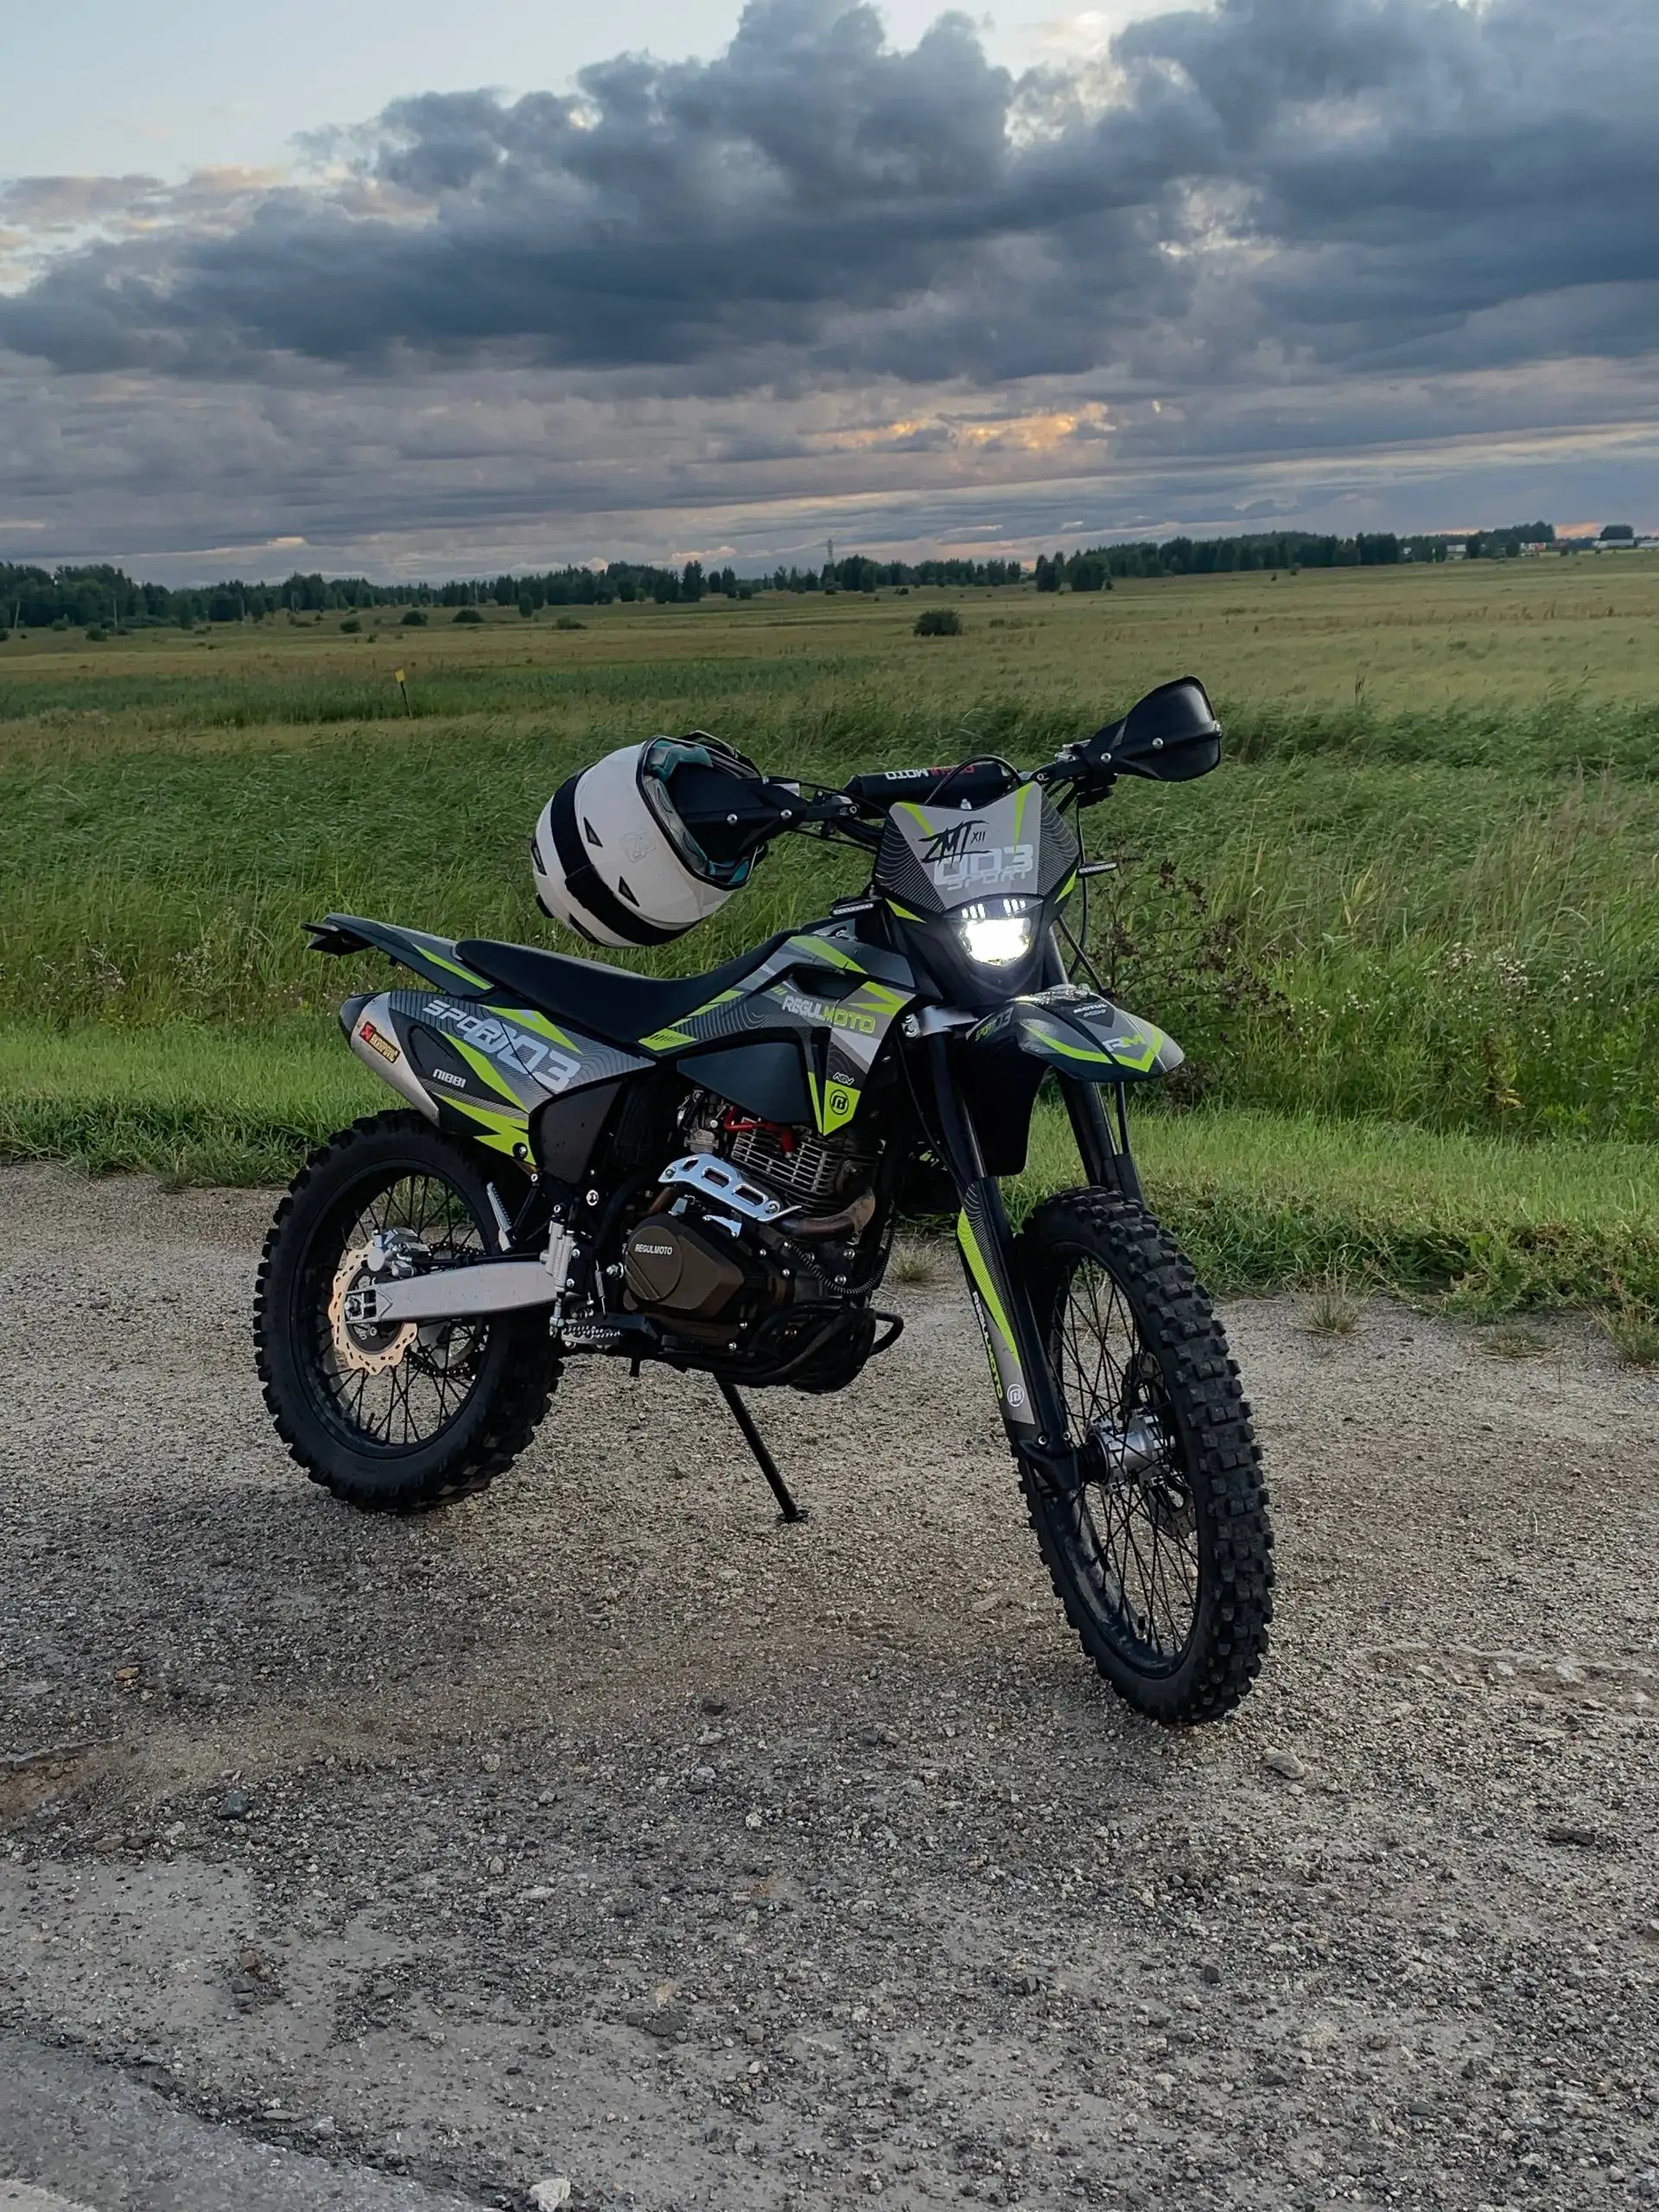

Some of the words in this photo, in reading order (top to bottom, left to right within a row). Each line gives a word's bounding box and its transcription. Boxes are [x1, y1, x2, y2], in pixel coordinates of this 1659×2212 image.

[782, 995, 876, 1033] REGULMOTO
[432, 1068, 467, 1089] NIBBI
[634, 1243, 673, 1255] REGULMOTO
